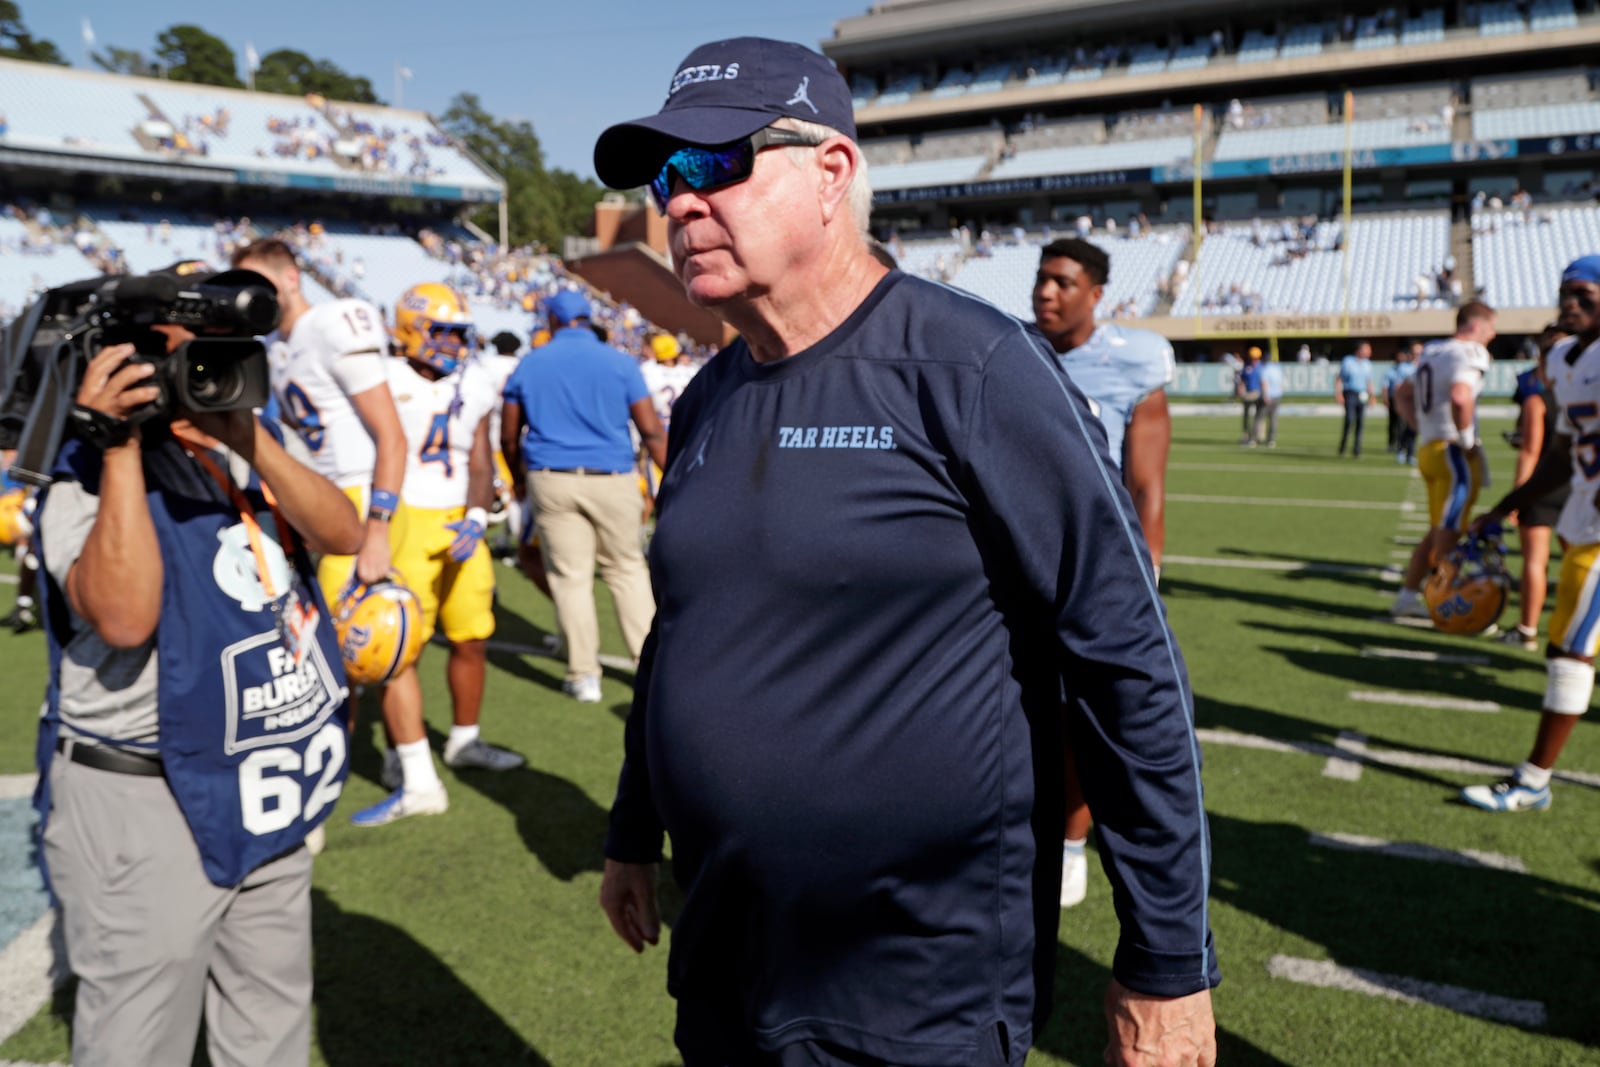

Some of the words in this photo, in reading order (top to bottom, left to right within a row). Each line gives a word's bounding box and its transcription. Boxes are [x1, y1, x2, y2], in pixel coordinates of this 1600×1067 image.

[341, 307, 373, 336] 19
[419, 412, 454, 478] 4
[778, 427, 819, 449] TAR
[238, 723, 348, 836] 62
